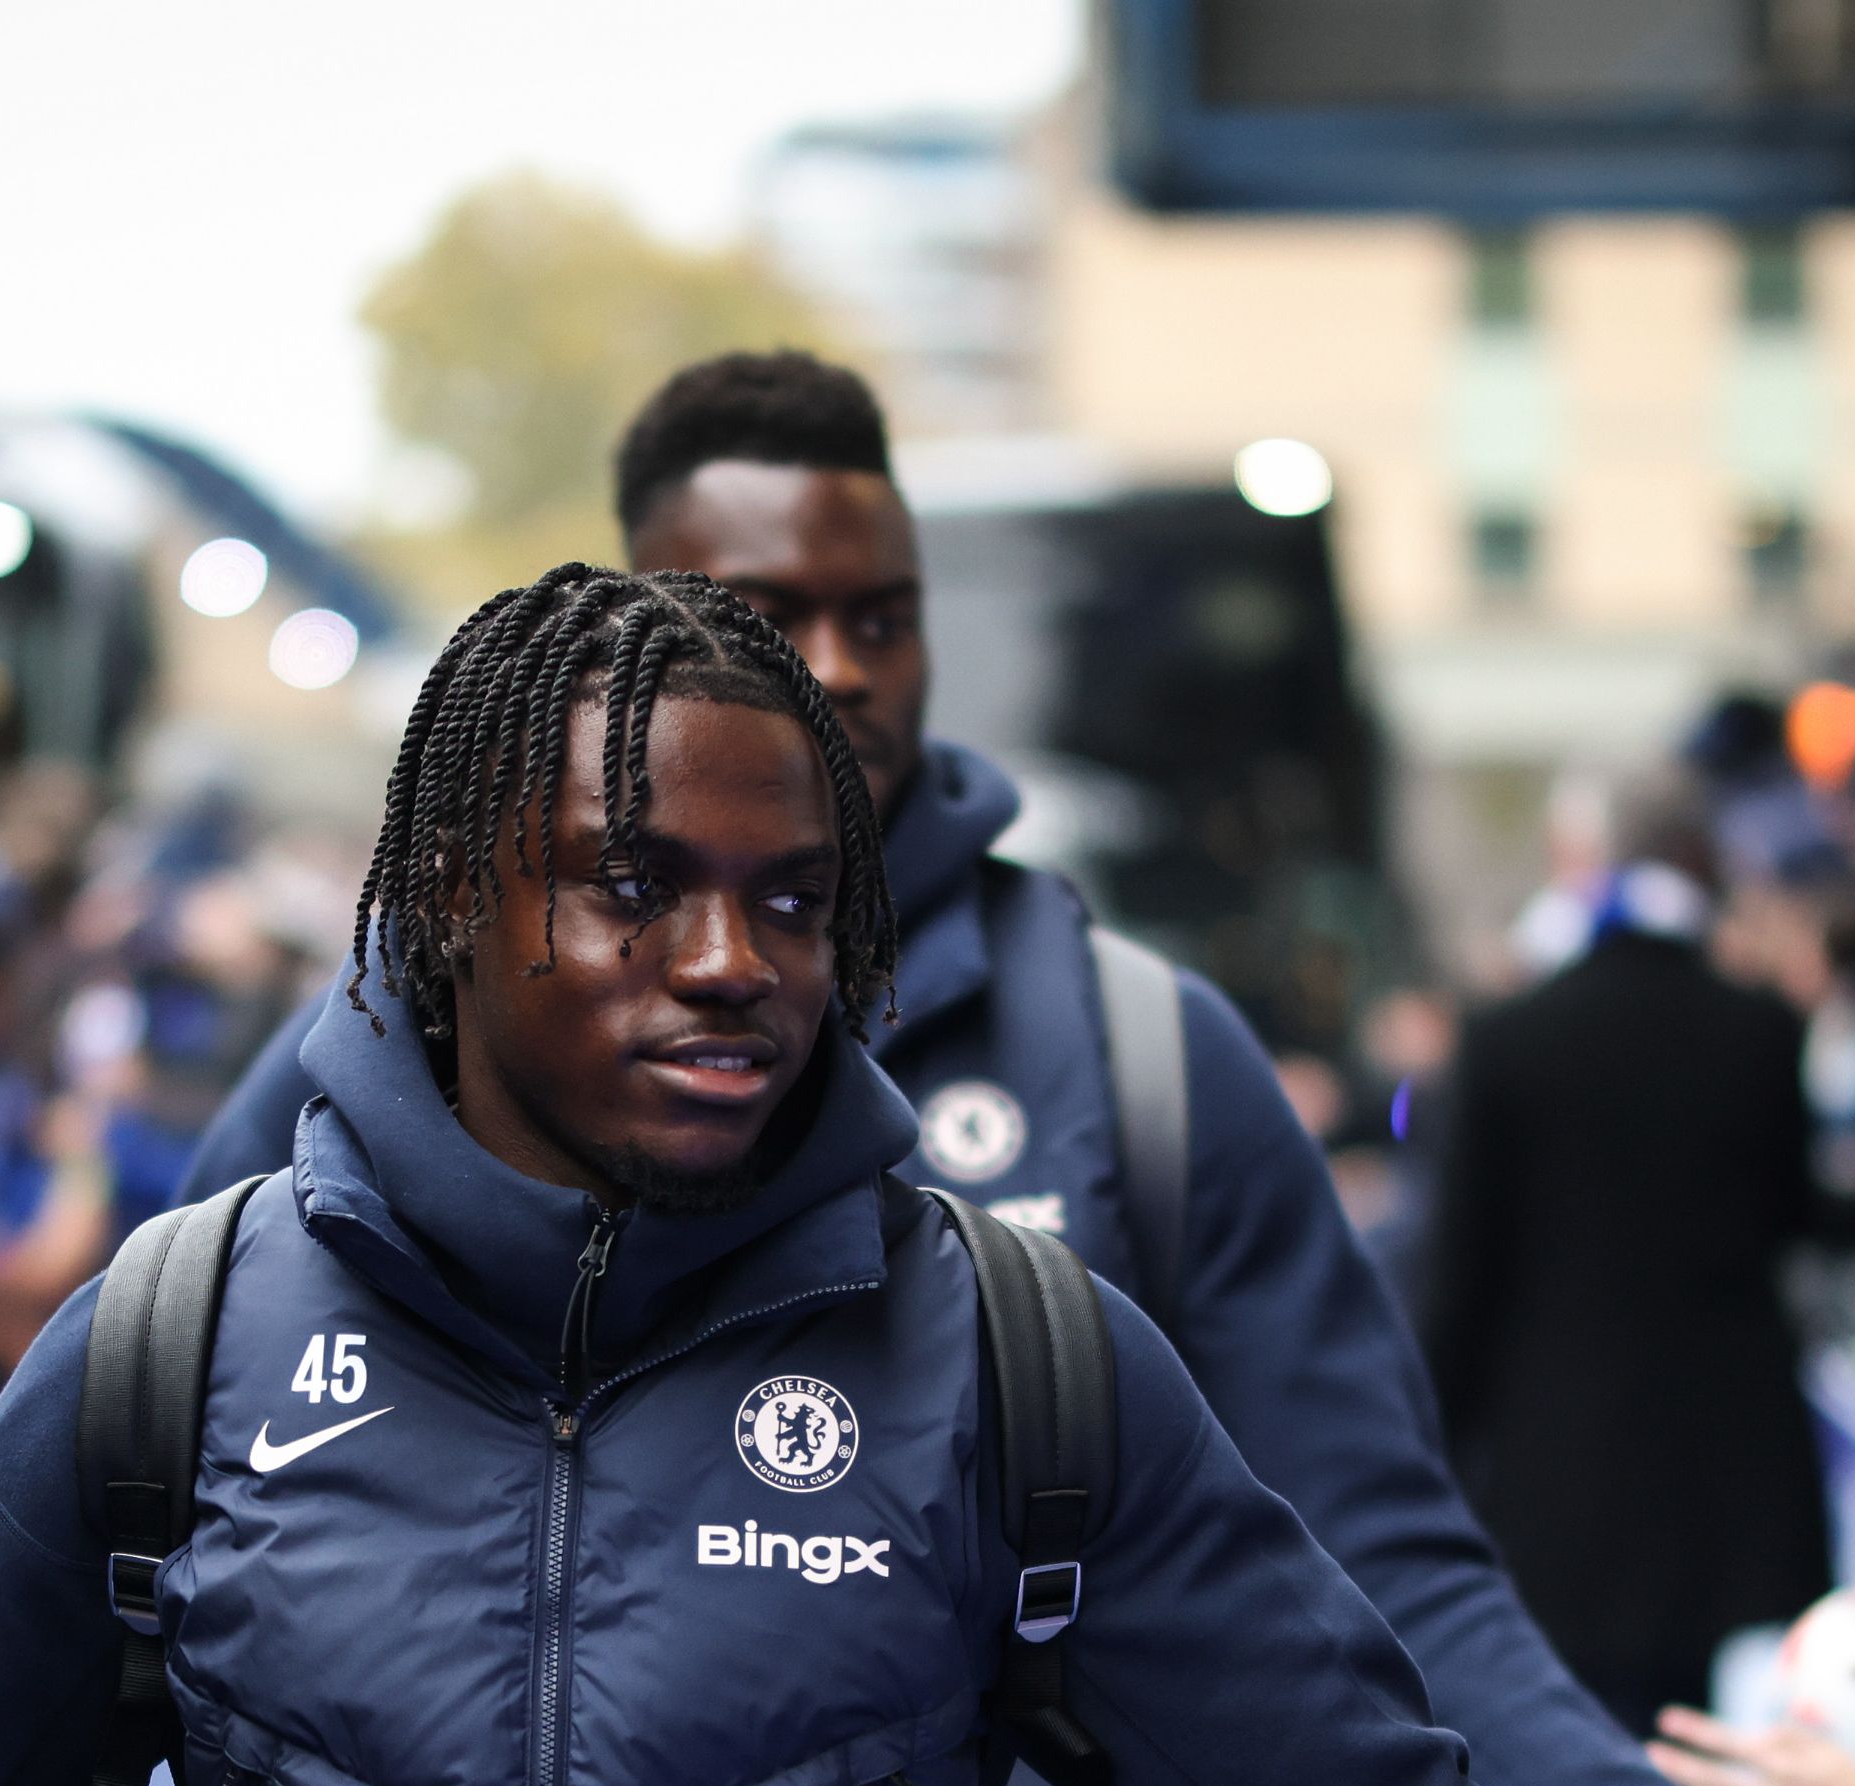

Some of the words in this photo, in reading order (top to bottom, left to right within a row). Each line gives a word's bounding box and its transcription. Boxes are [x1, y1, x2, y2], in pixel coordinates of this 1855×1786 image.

[291, 1333, 368, 1404] 45
[758, 1380, 839, 1409] CHELSEA
[754, 1461, 806, 1488] FOOTBALL
[809, 1468, 836, 1487] CLUB
